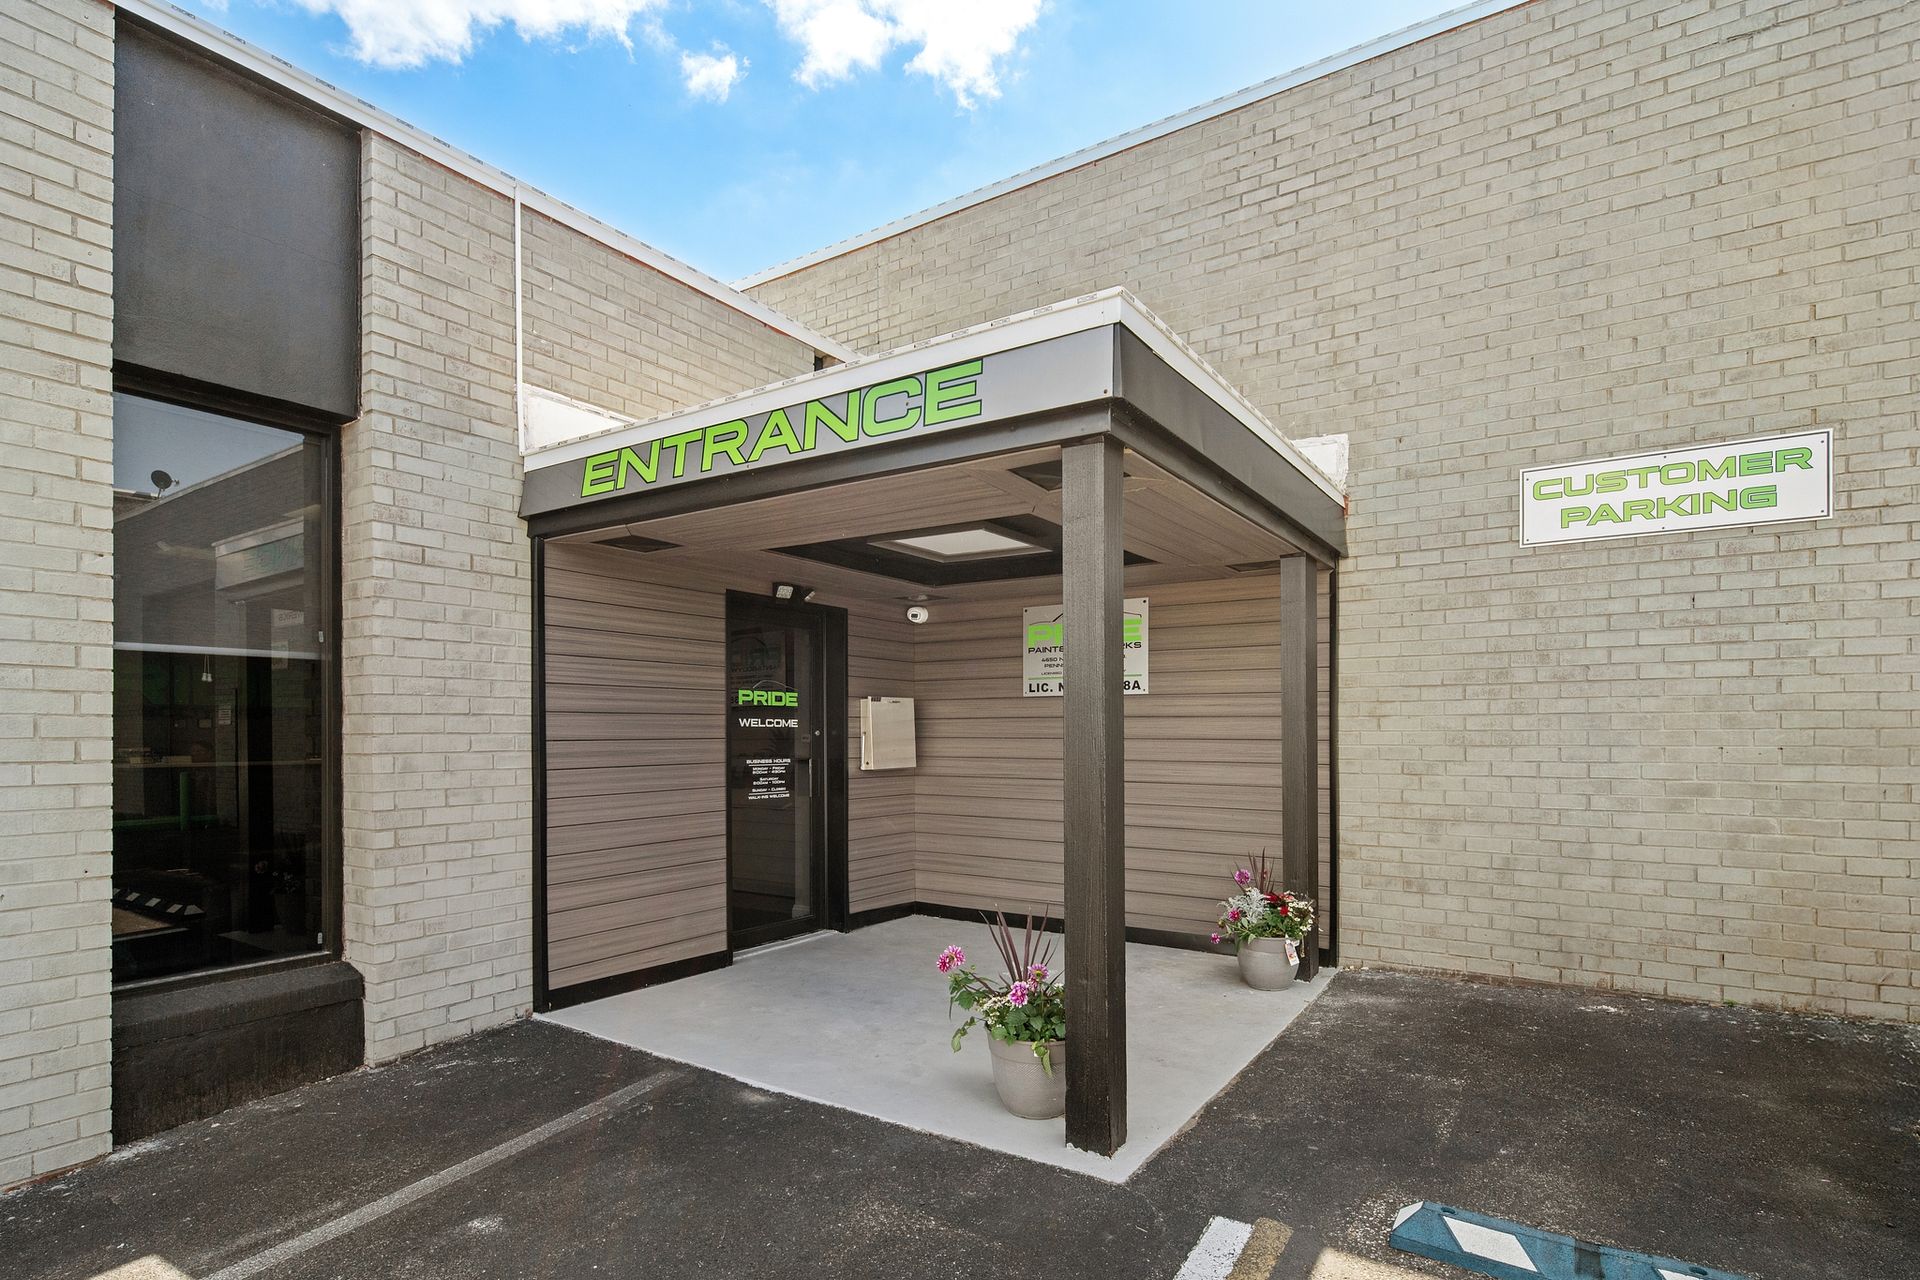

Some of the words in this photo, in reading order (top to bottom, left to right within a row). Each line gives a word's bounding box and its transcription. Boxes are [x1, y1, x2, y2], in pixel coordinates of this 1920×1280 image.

[581, 359, 983, 498] ENTRANCE
[1532, 446, 1814, 501] CUSTOMER
[1560, 484, 1778, 529] PARKING
[738, 690, 799, 707] PRIDE
[1028, 683, 1053, 693] LIC.
[738, 718, 798, 728] WELCOME
